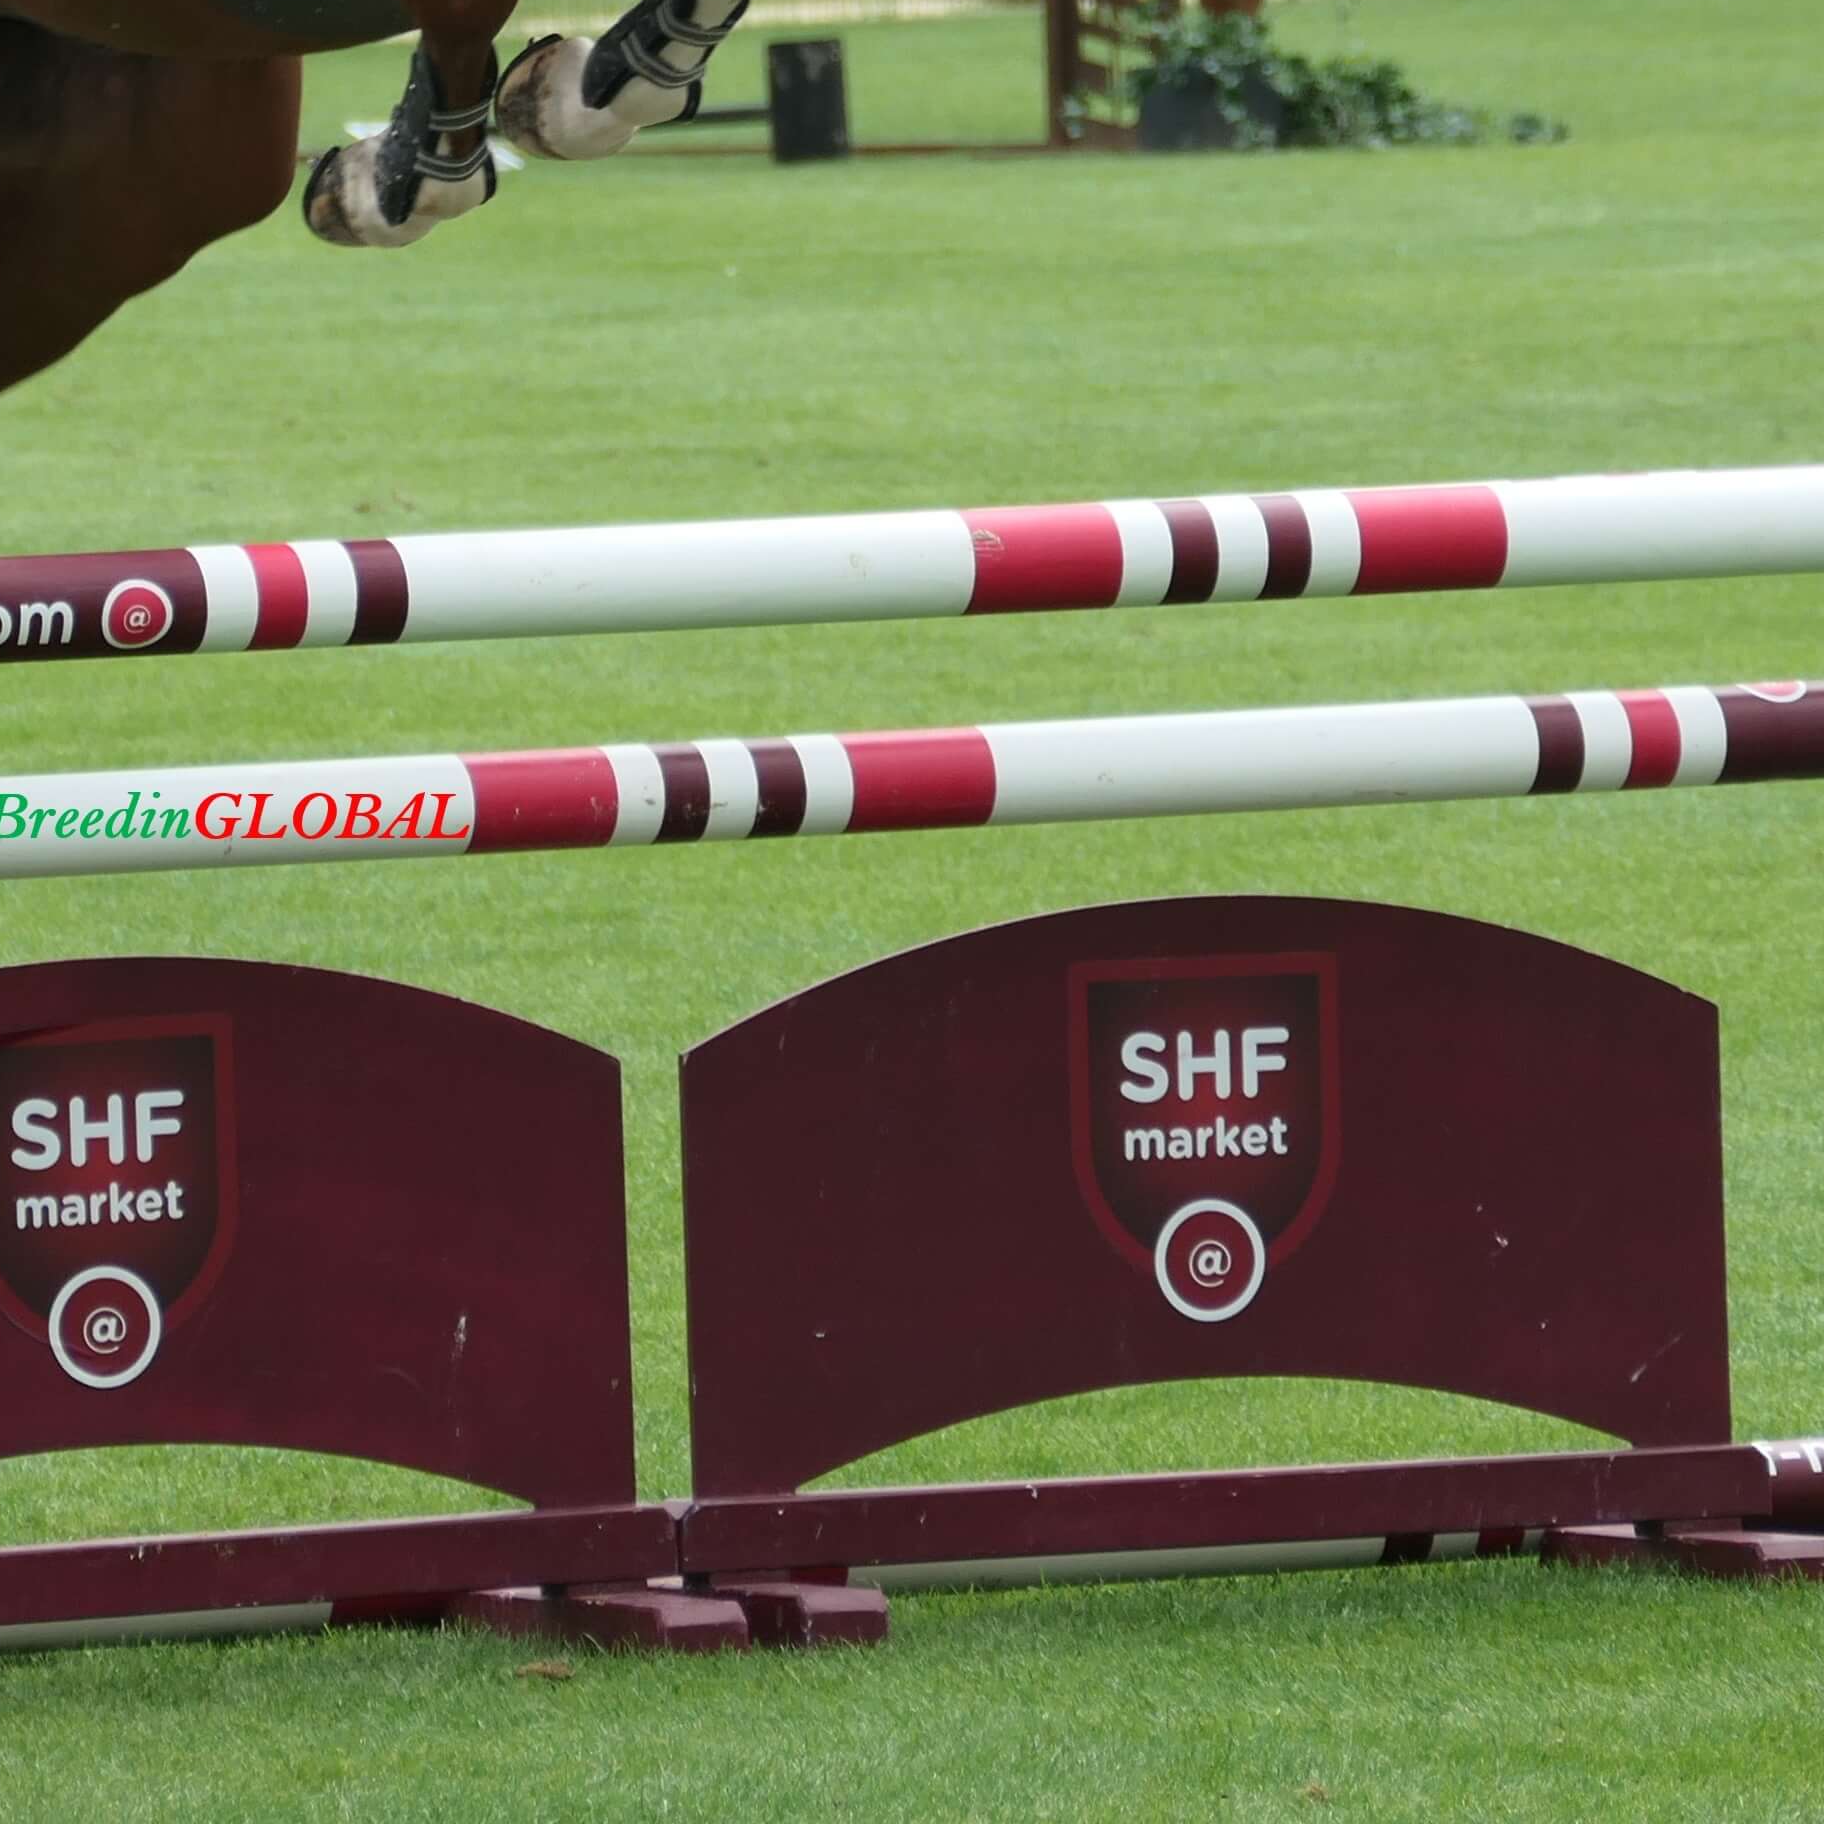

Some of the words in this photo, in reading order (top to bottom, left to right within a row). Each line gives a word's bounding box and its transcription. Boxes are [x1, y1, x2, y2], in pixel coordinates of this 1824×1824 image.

[1119, 1025, 1291, 1104] SHF
[10, 1088, 184, 1172] SHF
[1123, 1114, 1288, 1162] market
[14, 1179, 185, 1231] market
[1188, 1238, 1232, 1288] @
[83, 1305, 127, 1354] @
